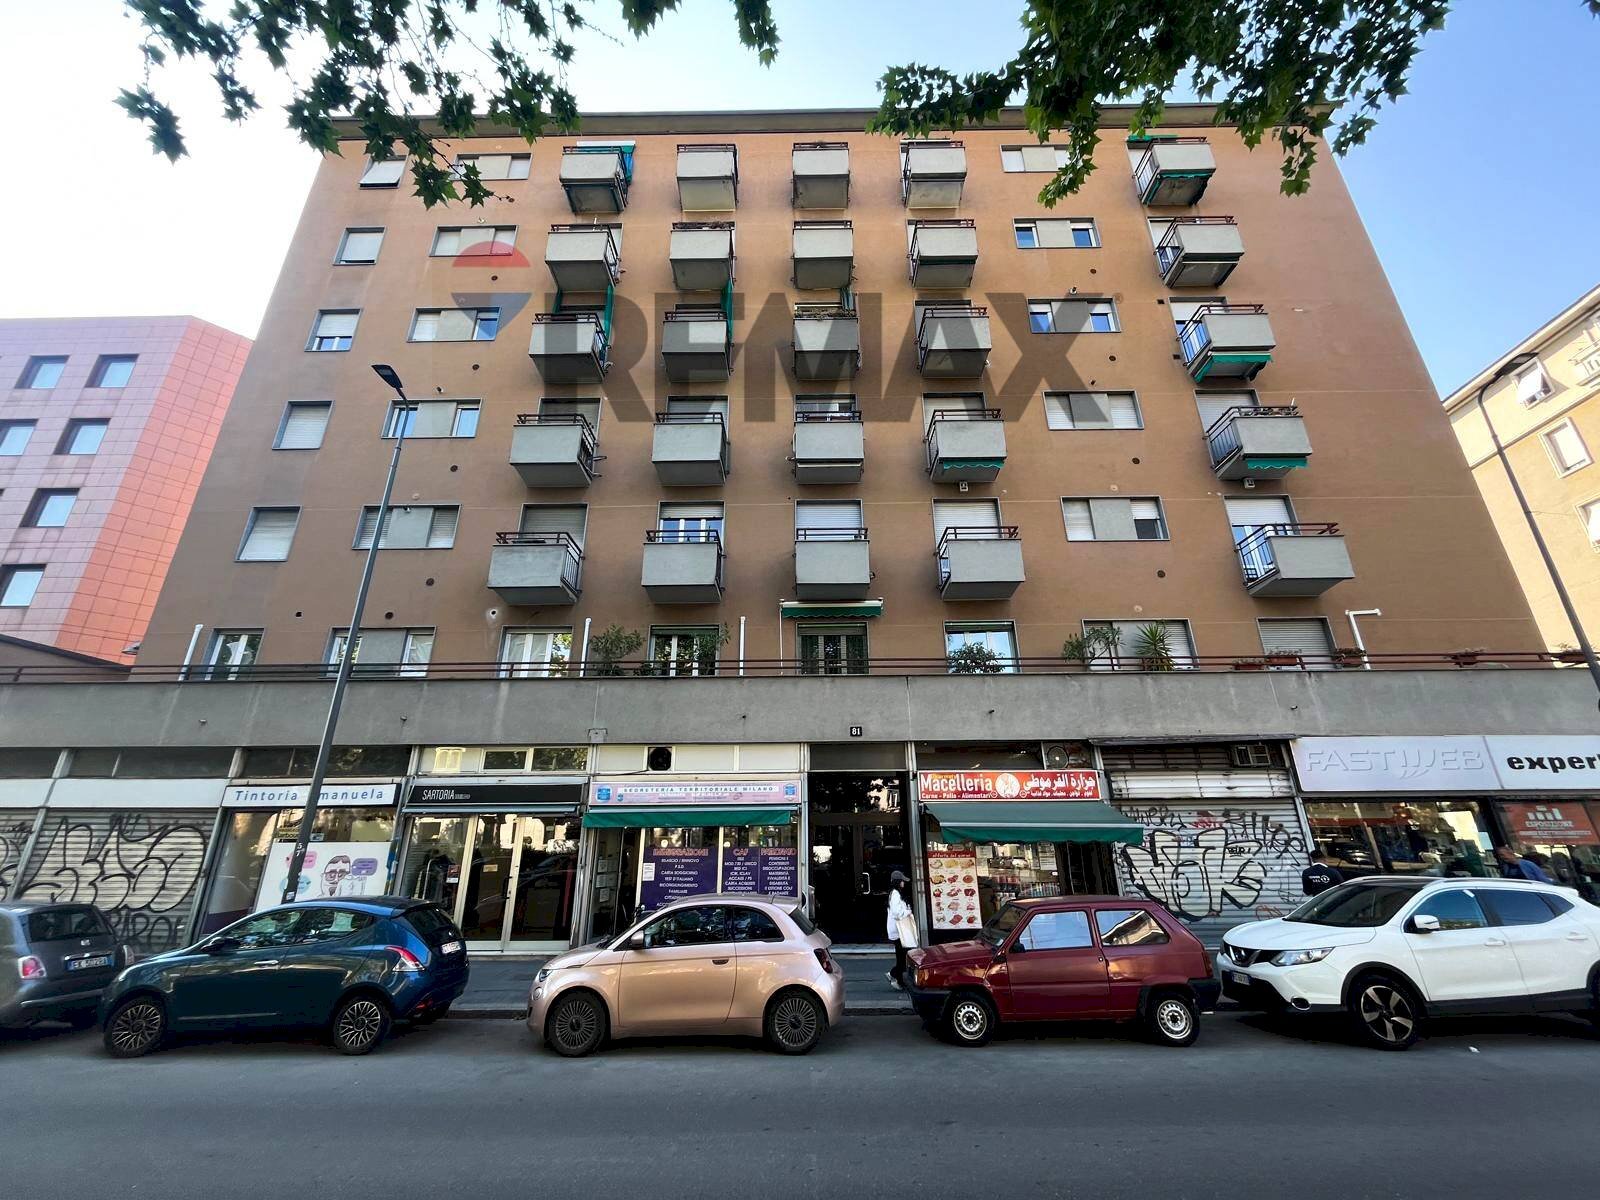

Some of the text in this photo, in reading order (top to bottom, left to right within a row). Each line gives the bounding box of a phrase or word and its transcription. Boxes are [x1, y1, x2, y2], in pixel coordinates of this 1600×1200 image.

[1306, 749, 1485, 778] FASTWEB
[920, 774, 992, 792] Macelleria
[1070, 773, 1096, 790] جزارة
[236, 788, 384, 800] Tintoria manuela
[422, 789, 455, 800] SARTORIA
[733, 848, 748, 856] CAF
